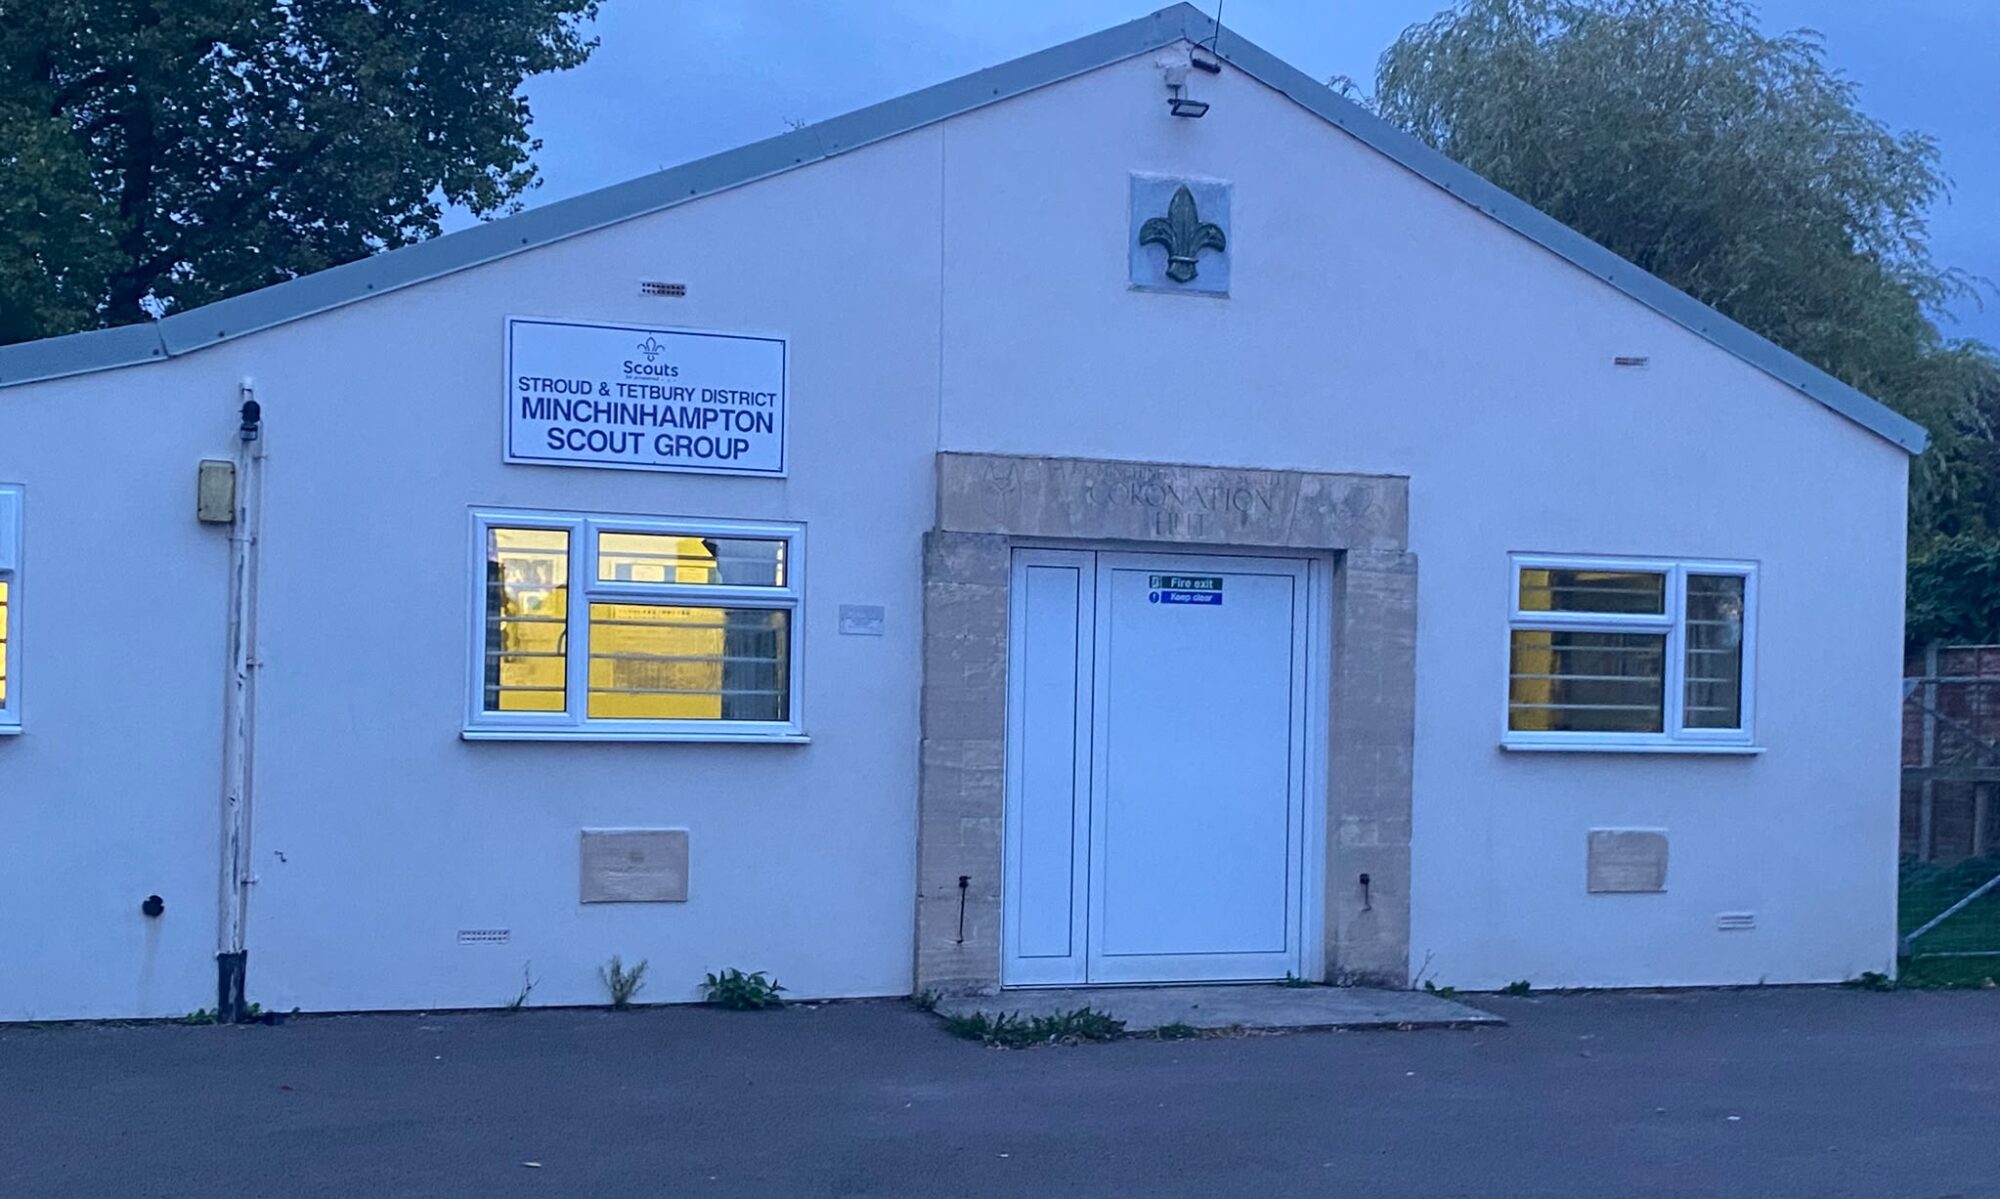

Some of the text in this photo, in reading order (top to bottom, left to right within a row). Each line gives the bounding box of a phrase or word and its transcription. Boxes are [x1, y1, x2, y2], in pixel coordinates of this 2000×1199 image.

[623, 360, 679, 377] Scouts
[518, 376, 777, 407] STROUD & TETBURY DISTRICT
[521, 396, 774, 433] MINCHINHAMPTON
[547, 427, 749, 460] SCOUT GROUP
[1085, 482, 1273, 512] CORONATION
[1170, 577, 1214, 589] Fire exit
